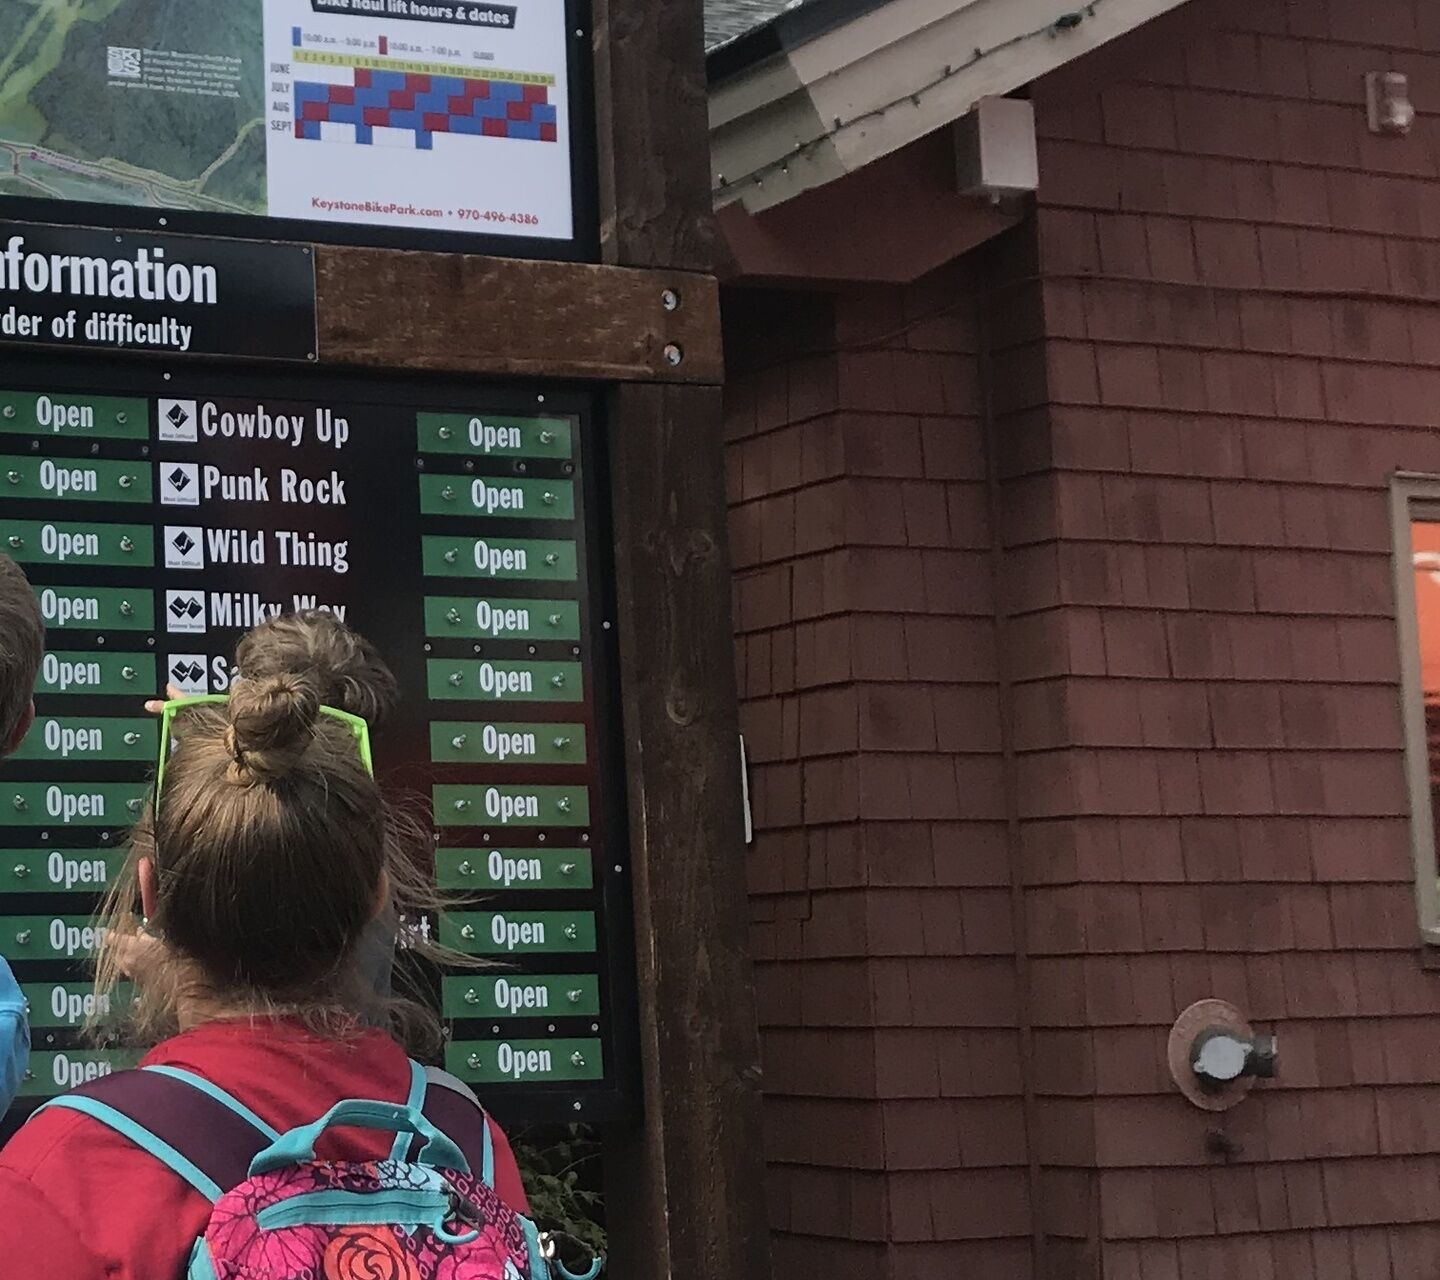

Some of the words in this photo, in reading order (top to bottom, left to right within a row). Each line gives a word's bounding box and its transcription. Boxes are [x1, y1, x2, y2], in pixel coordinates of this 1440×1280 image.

[411, 0, 453, 20] hours
[455, 6, 466, 21] &
[468, 7, 511, 26] dates
[311, 197, 444, 219] KeystoneBikePark.com
[458, 209, 539, 226] 970-496-4386
[52, 311, 76, 338] of
[85, 311, 192, 350] difficulty
[37, 396, 93, 432] Open
[202, 402, 304, 446] Cowboy
[316, 409, 348, 448] Up
[469, 418, 520, 452] Open
[40, 461, 96, 496] Open
[204, 466, 269, 501] Punk
[282, 469, 346, 504] Rock
[472, 479, 523, 513] Open
[42, 525, 98, 560] Open
[207, 529, 264, 564] Wild
[275, 532, 348, 573] Thing
[474, 541, 526, 575] Open
[42, 589, 98, 625] Open
[477, 601, 529, 635] Open
[43, 654, 100, 690] Open
[480, 663, 532, 697] Open
[45, 720, 102, 756] Open
[483, 725, 535, 760] Open
[47, 786, 104, 822] Open
[486, 788, 538, 823] Open
[47, 851, 107, 890] Open
[488, 851, 541, 886] Open
[49, 917, 108, 956] Open
[492, 915, 544, 950] Open
[495, 979, 548, 1014] Open
[498, 1043, 551, 1078] Open
